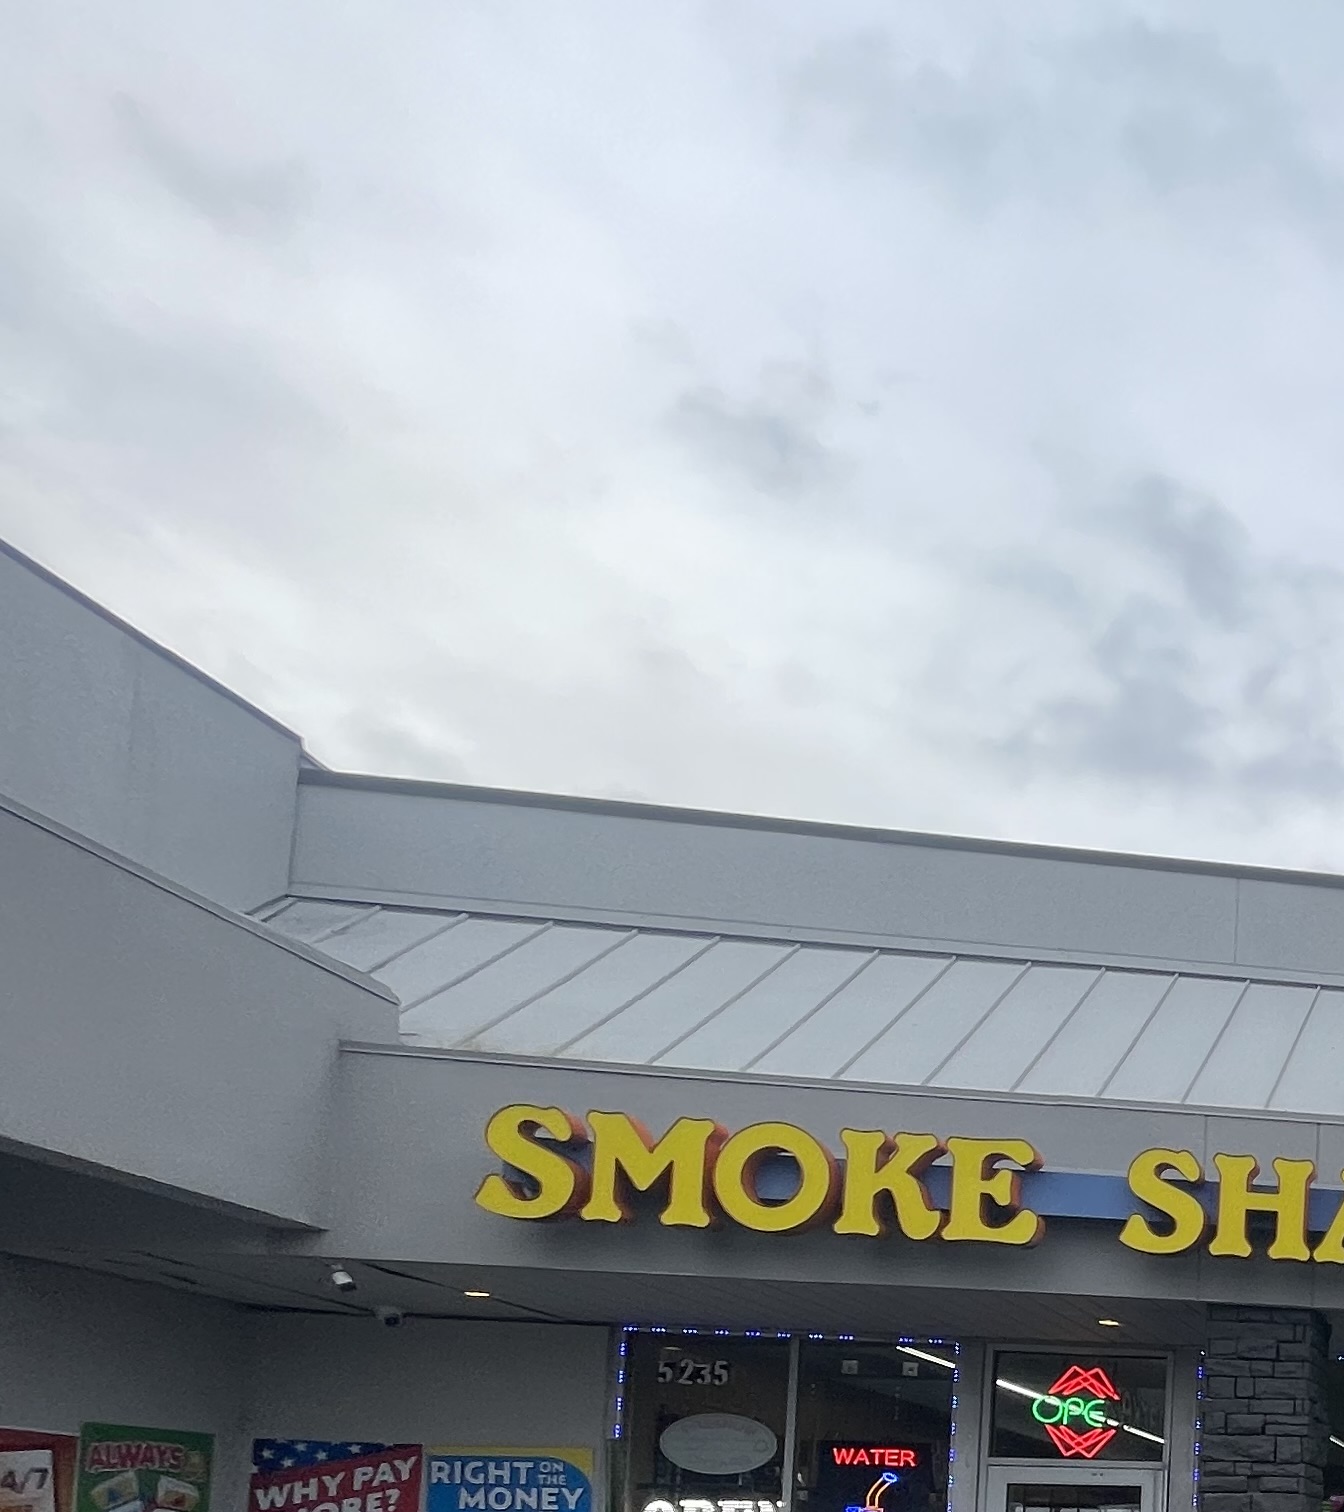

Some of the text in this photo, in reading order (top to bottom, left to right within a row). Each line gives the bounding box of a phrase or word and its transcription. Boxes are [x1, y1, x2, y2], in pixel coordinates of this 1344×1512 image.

[475, 1103, 1042, 1245] SMOKE
[657, 1359, 729, 1386] 5235
[87, 1442, 186, 1472] ALWAYS
[832, 1447, 916, 1467] WATER
[254, 1456, 417, 1511] WHY PAY
[430, 1461, 564, 1485] RIGHT ON
[537, 1474, 567, 1486] THE
[458, 1487, 585, 1511] MONEY
